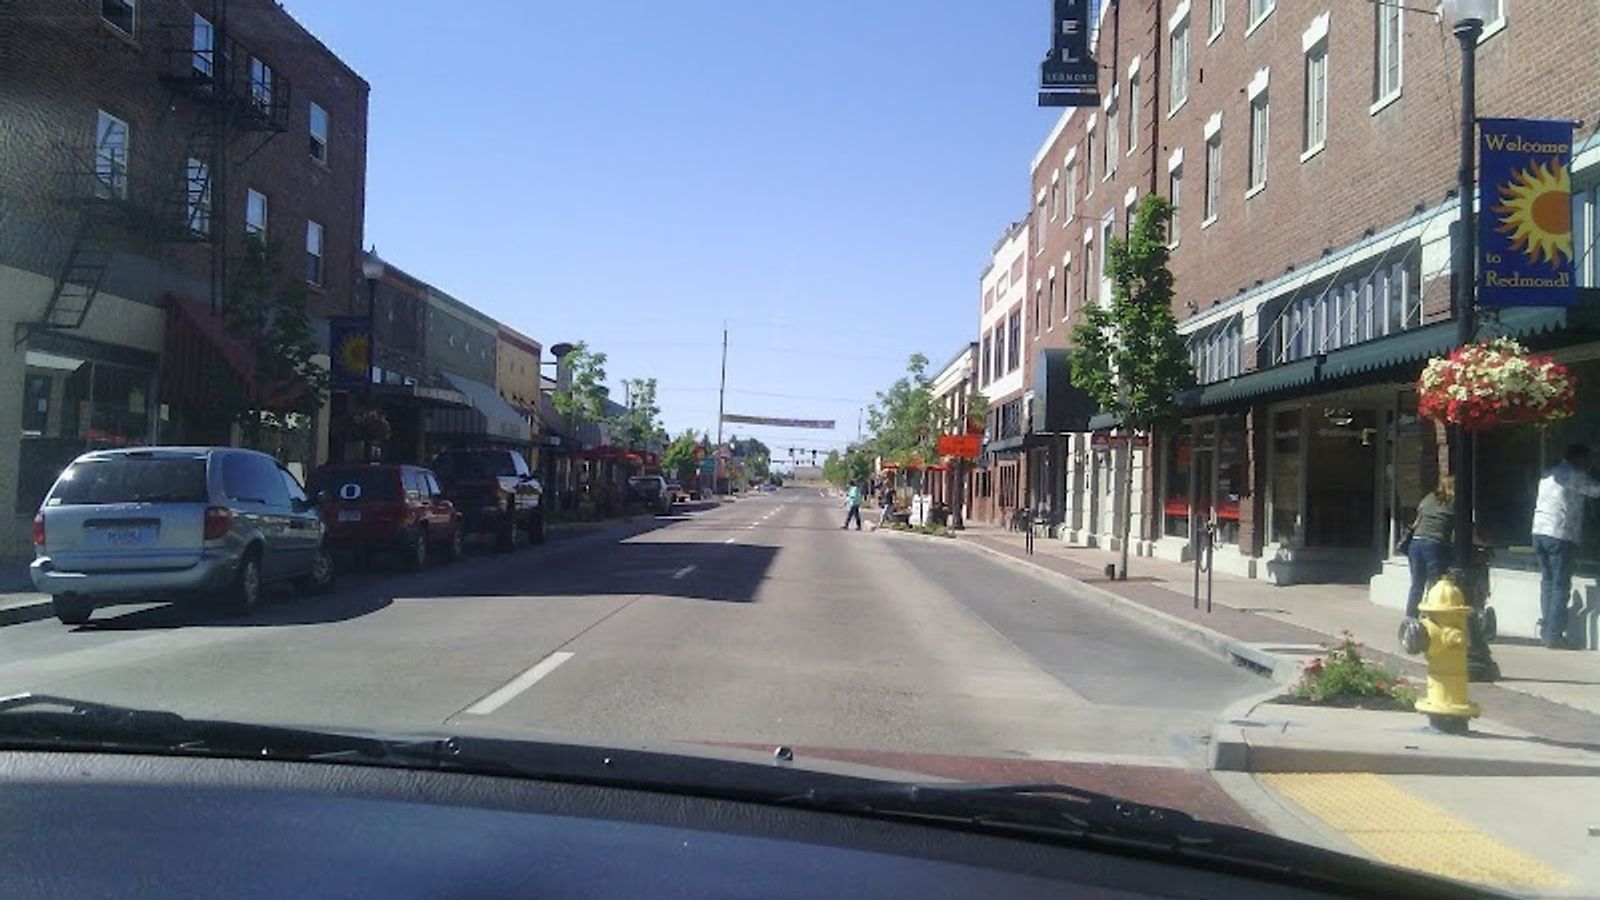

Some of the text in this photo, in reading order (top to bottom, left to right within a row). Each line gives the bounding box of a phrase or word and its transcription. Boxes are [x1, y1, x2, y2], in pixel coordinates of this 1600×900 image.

[1485, 134, 1568, 153] Welcome
[1486, 253, 1501, 264] to
[1485, 271, 1569, 288] Redmond!
